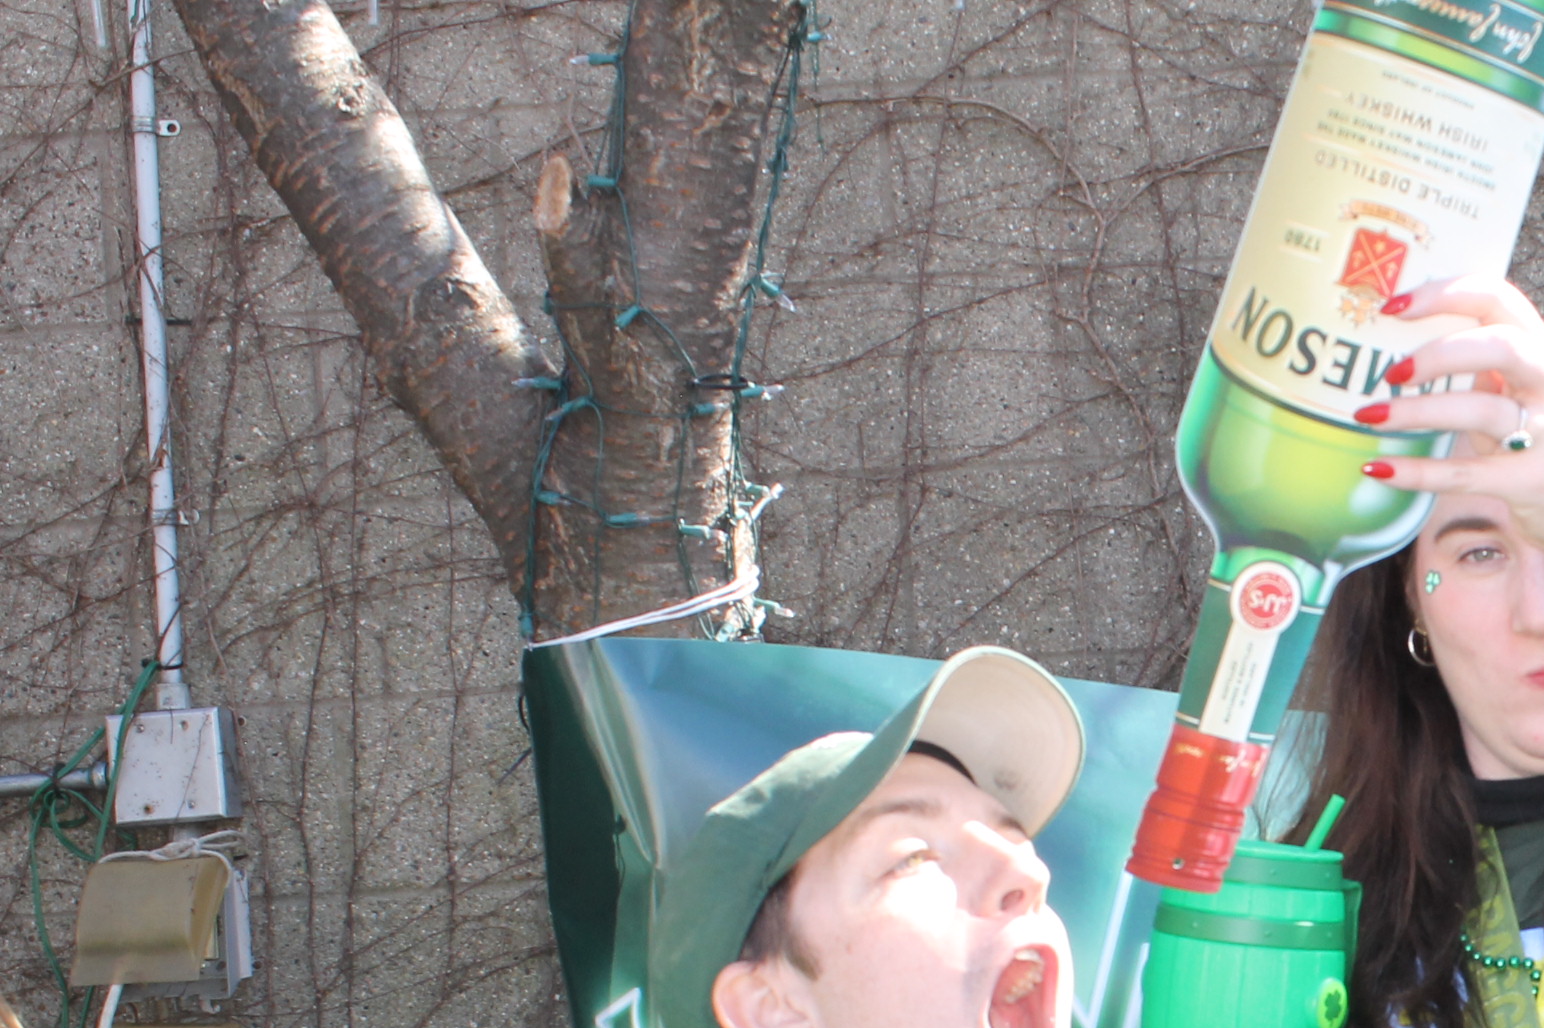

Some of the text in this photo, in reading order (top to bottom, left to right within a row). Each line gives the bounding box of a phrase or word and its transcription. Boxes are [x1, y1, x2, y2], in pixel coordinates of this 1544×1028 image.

[1344, 91, 1431, 130] WHISKEY
[1439, 124, 1487, 150] IRISH
[1314, 150, 1410, 193] DISTILLED
[1417, 186, 1478, 218] TRIPLE
